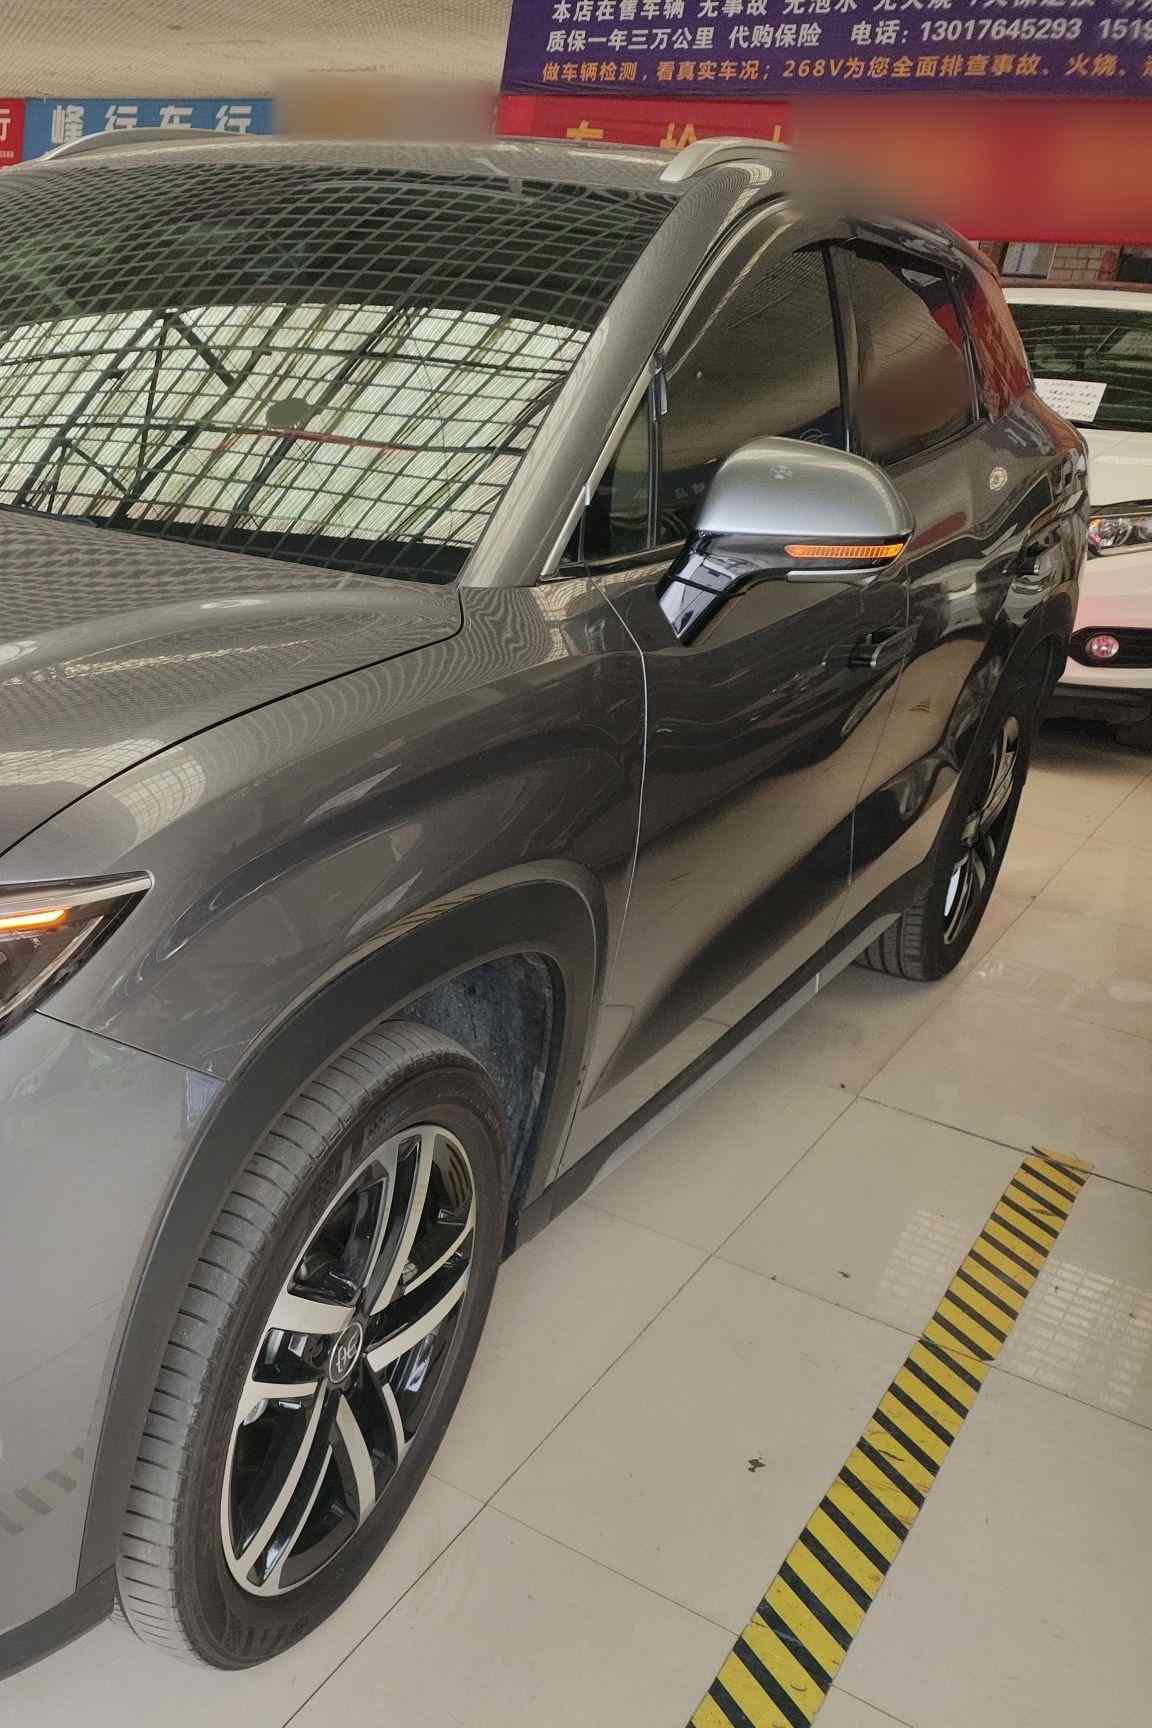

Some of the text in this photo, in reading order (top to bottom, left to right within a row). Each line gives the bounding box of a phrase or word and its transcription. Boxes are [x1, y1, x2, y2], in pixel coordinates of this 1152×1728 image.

[546, 26, 715, 52] 质保一年三万公里
[729, 22, 822, 48] 代购保险
